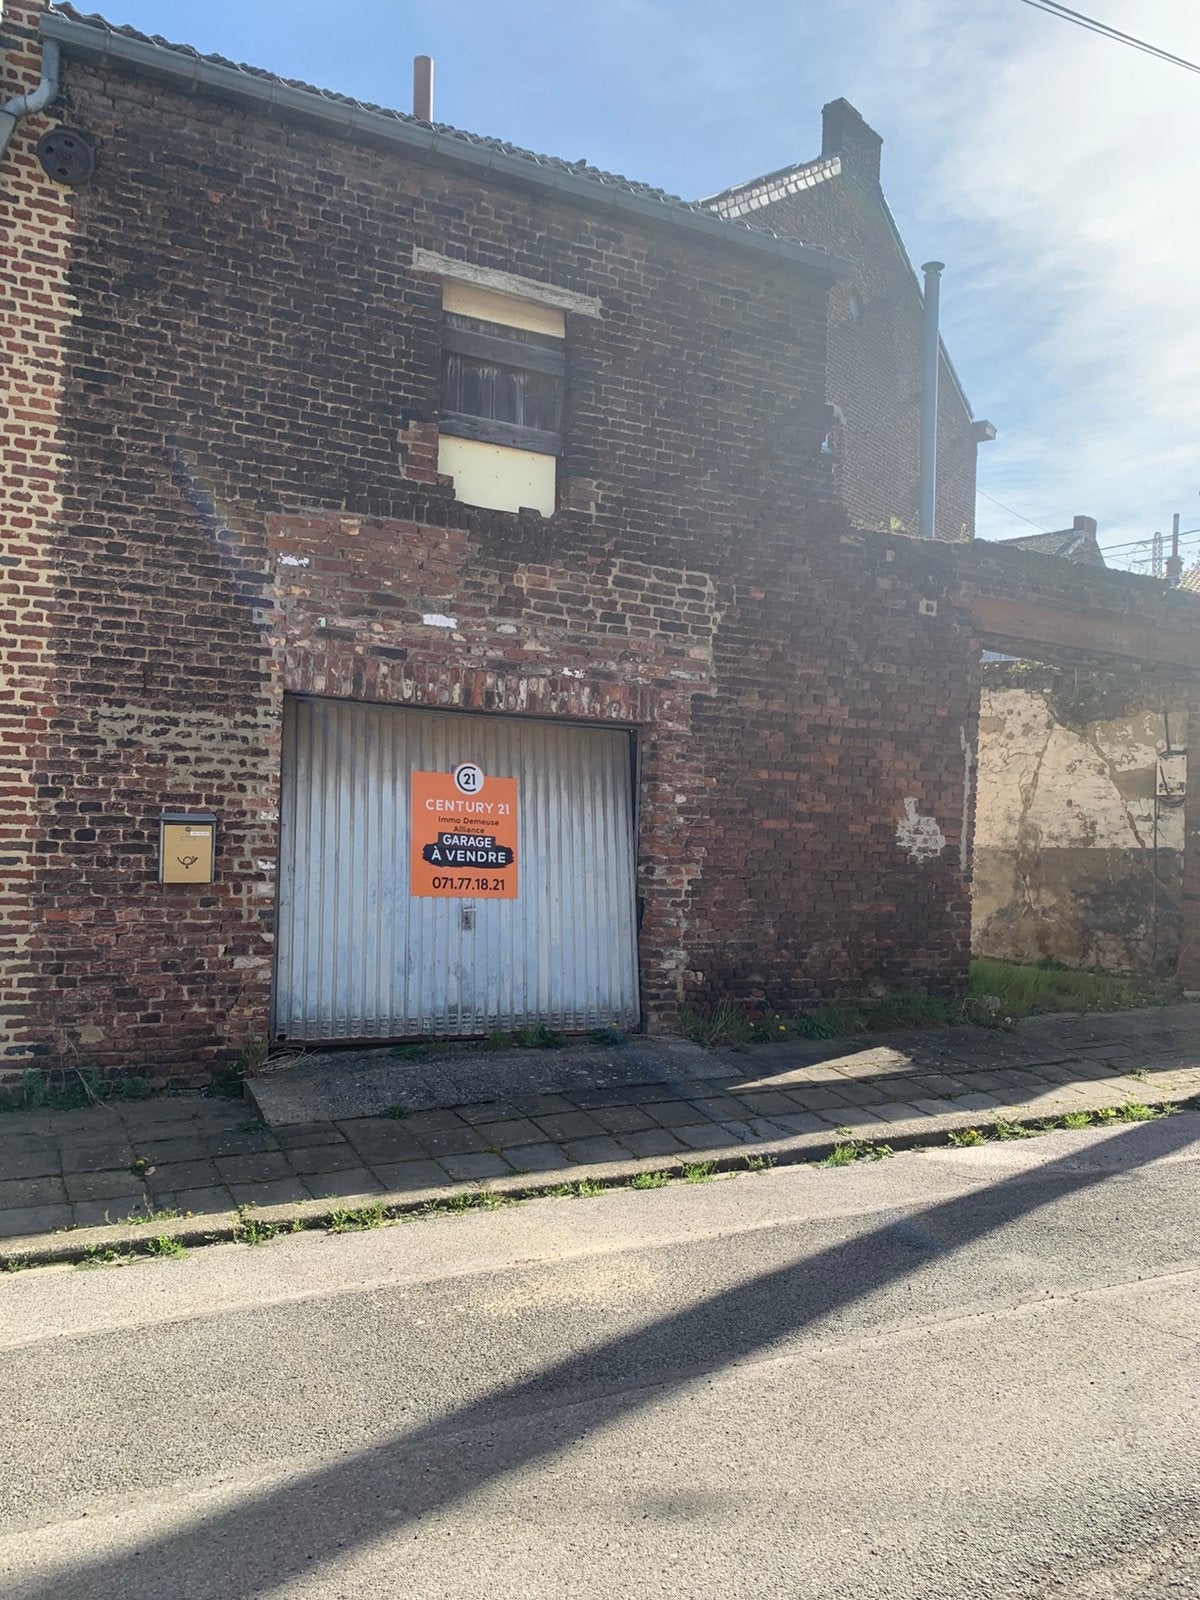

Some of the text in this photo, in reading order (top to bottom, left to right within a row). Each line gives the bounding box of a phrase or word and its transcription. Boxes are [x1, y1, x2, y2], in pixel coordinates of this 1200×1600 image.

[425, 798, 510, 815] CENTURY 21
[438, 816, 500, 826] Immo Demeuse
[453, 826, 485, 834] Alliance
[442, 834, 492, 848] GARAGE
[431, 846, 506, 863] À VENDRE
[432, 876, 505, 891] 071.77.18.21
